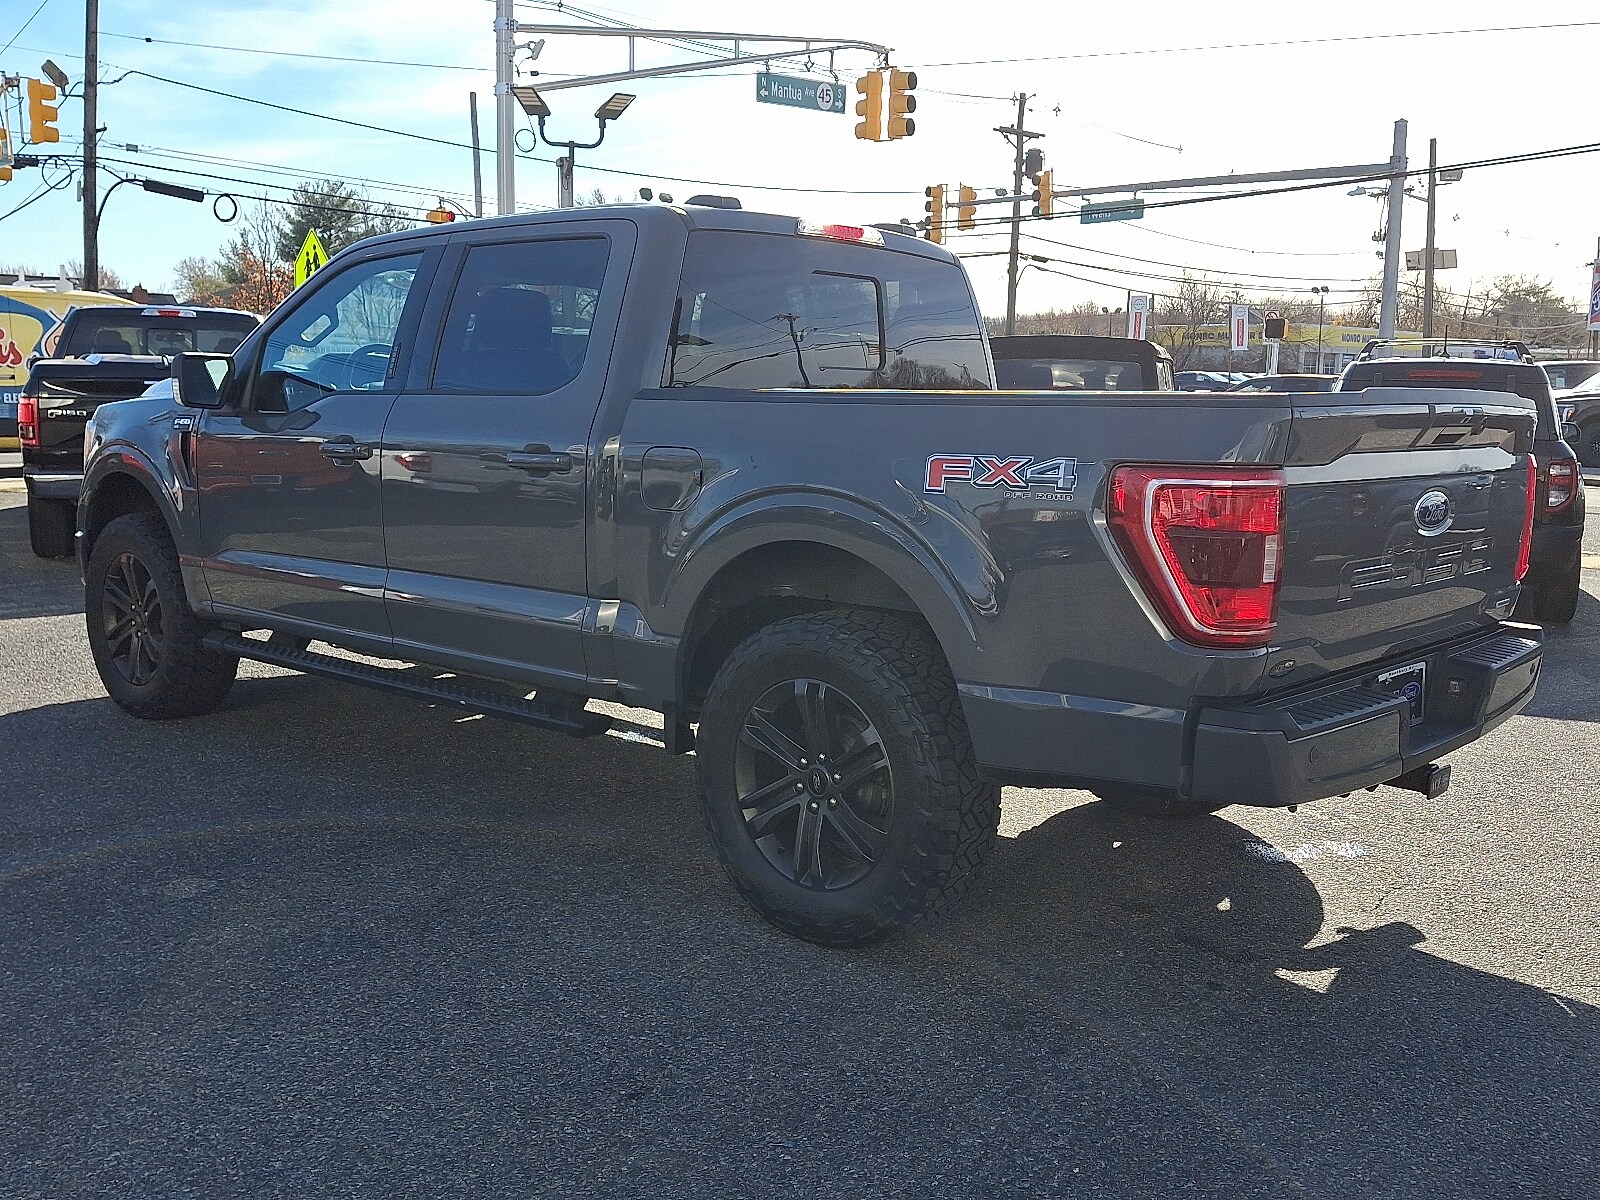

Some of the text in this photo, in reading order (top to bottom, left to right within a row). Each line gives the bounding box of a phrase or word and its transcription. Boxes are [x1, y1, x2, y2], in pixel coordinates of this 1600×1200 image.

[761, 76, 767, 87] N
[771, 81, 815, 100] Mantua Ave
[818, 89, 832, 103] 45
[837, 88, 842, 98] S
[924, 454, 1077, 494] FX4
[1035, 492, 1074, 501] ROAD
